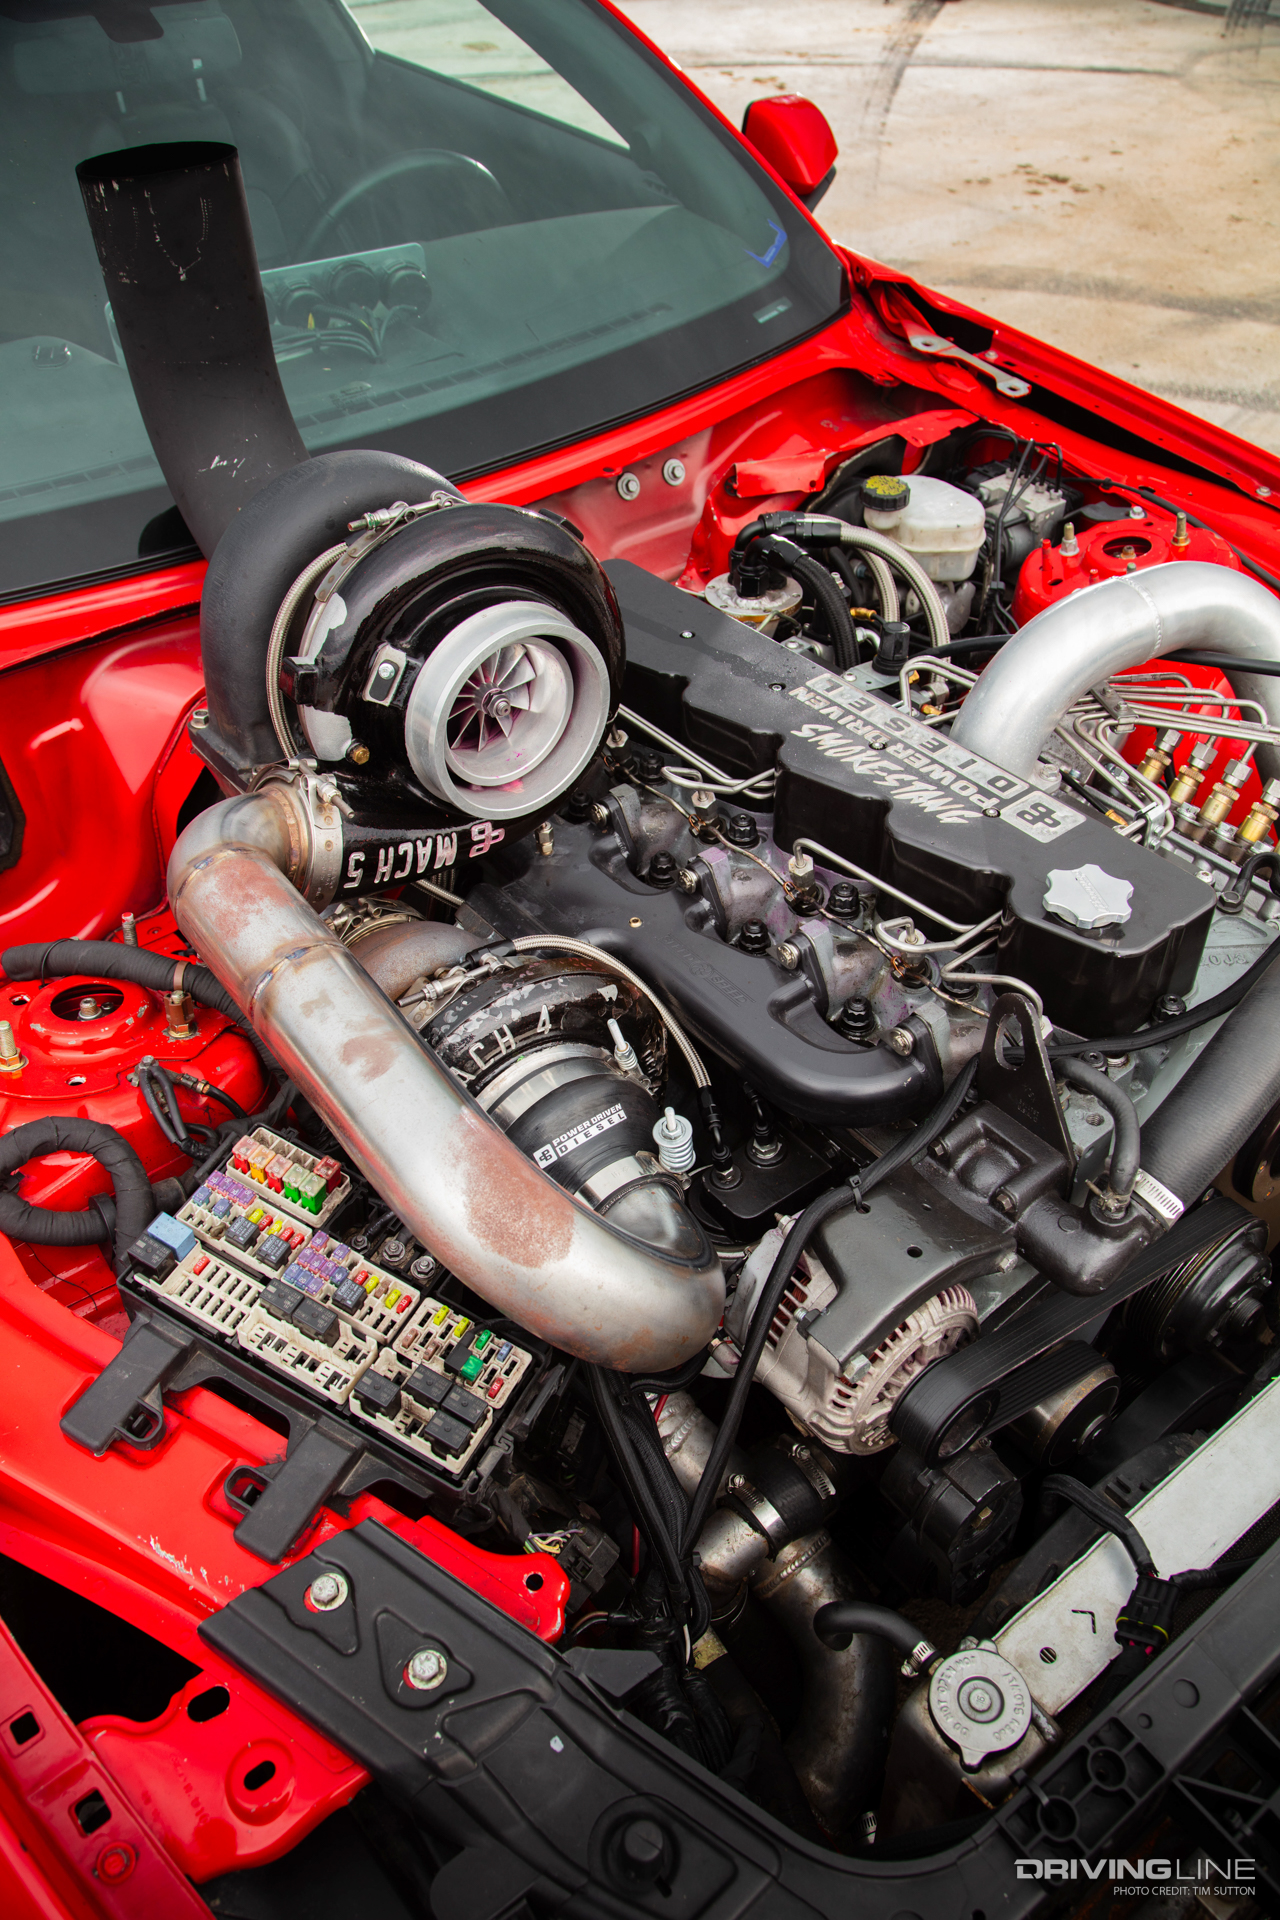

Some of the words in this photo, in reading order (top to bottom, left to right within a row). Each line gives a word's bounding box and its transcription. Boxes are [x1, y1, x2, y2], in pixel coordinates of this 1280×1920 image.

[788, 686, 892, 744] DRIVEN
[824, 682, 1020, 798] DIESEL
[885, 742, 1000, 808] POWER
[343, 851, 366, 889] 5
[373, 831, 458, 884] MACH
[450, 1024, 516, 1088] ACH
[536, 1004, 552, 1035] 4
[551, 1120, 591, 1147] POWER
[591, 1103, 622, 1124] DRIVEN
[559, 1112, 626, 1155] DIESEL
